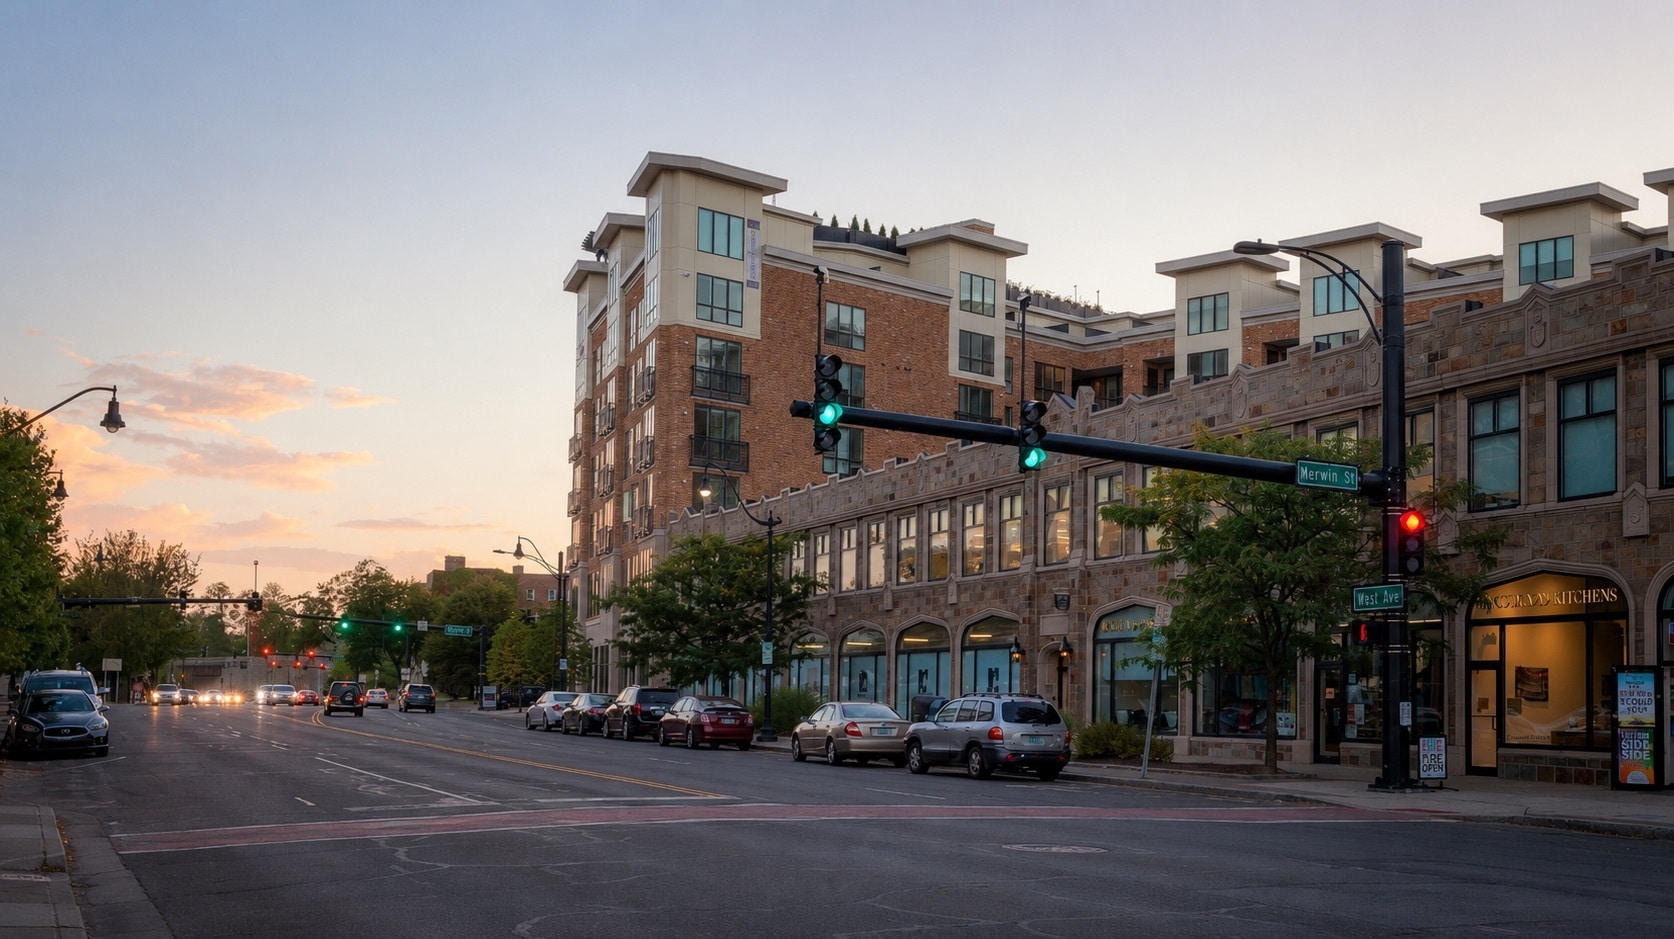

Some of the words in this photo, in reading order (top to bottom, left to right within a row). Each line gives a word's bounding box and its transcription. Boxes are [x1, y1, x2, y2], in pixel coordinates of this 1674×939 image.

[1300, 466, 1338, 483] Merwin
[1344, 470, 1355, 485] St
[1358, 592, 1378, 606] West
[1383, 590, 1399, 604] Ave
[1554, 588, 1617, 604] KITCHENS
[1621, 739, 1649, 750] SIDE
[1422, 754, 1443, 763] ARE
[1621, 750, 1650, 760] SIDE
[1422, 764, 1443, 772] OPEN
